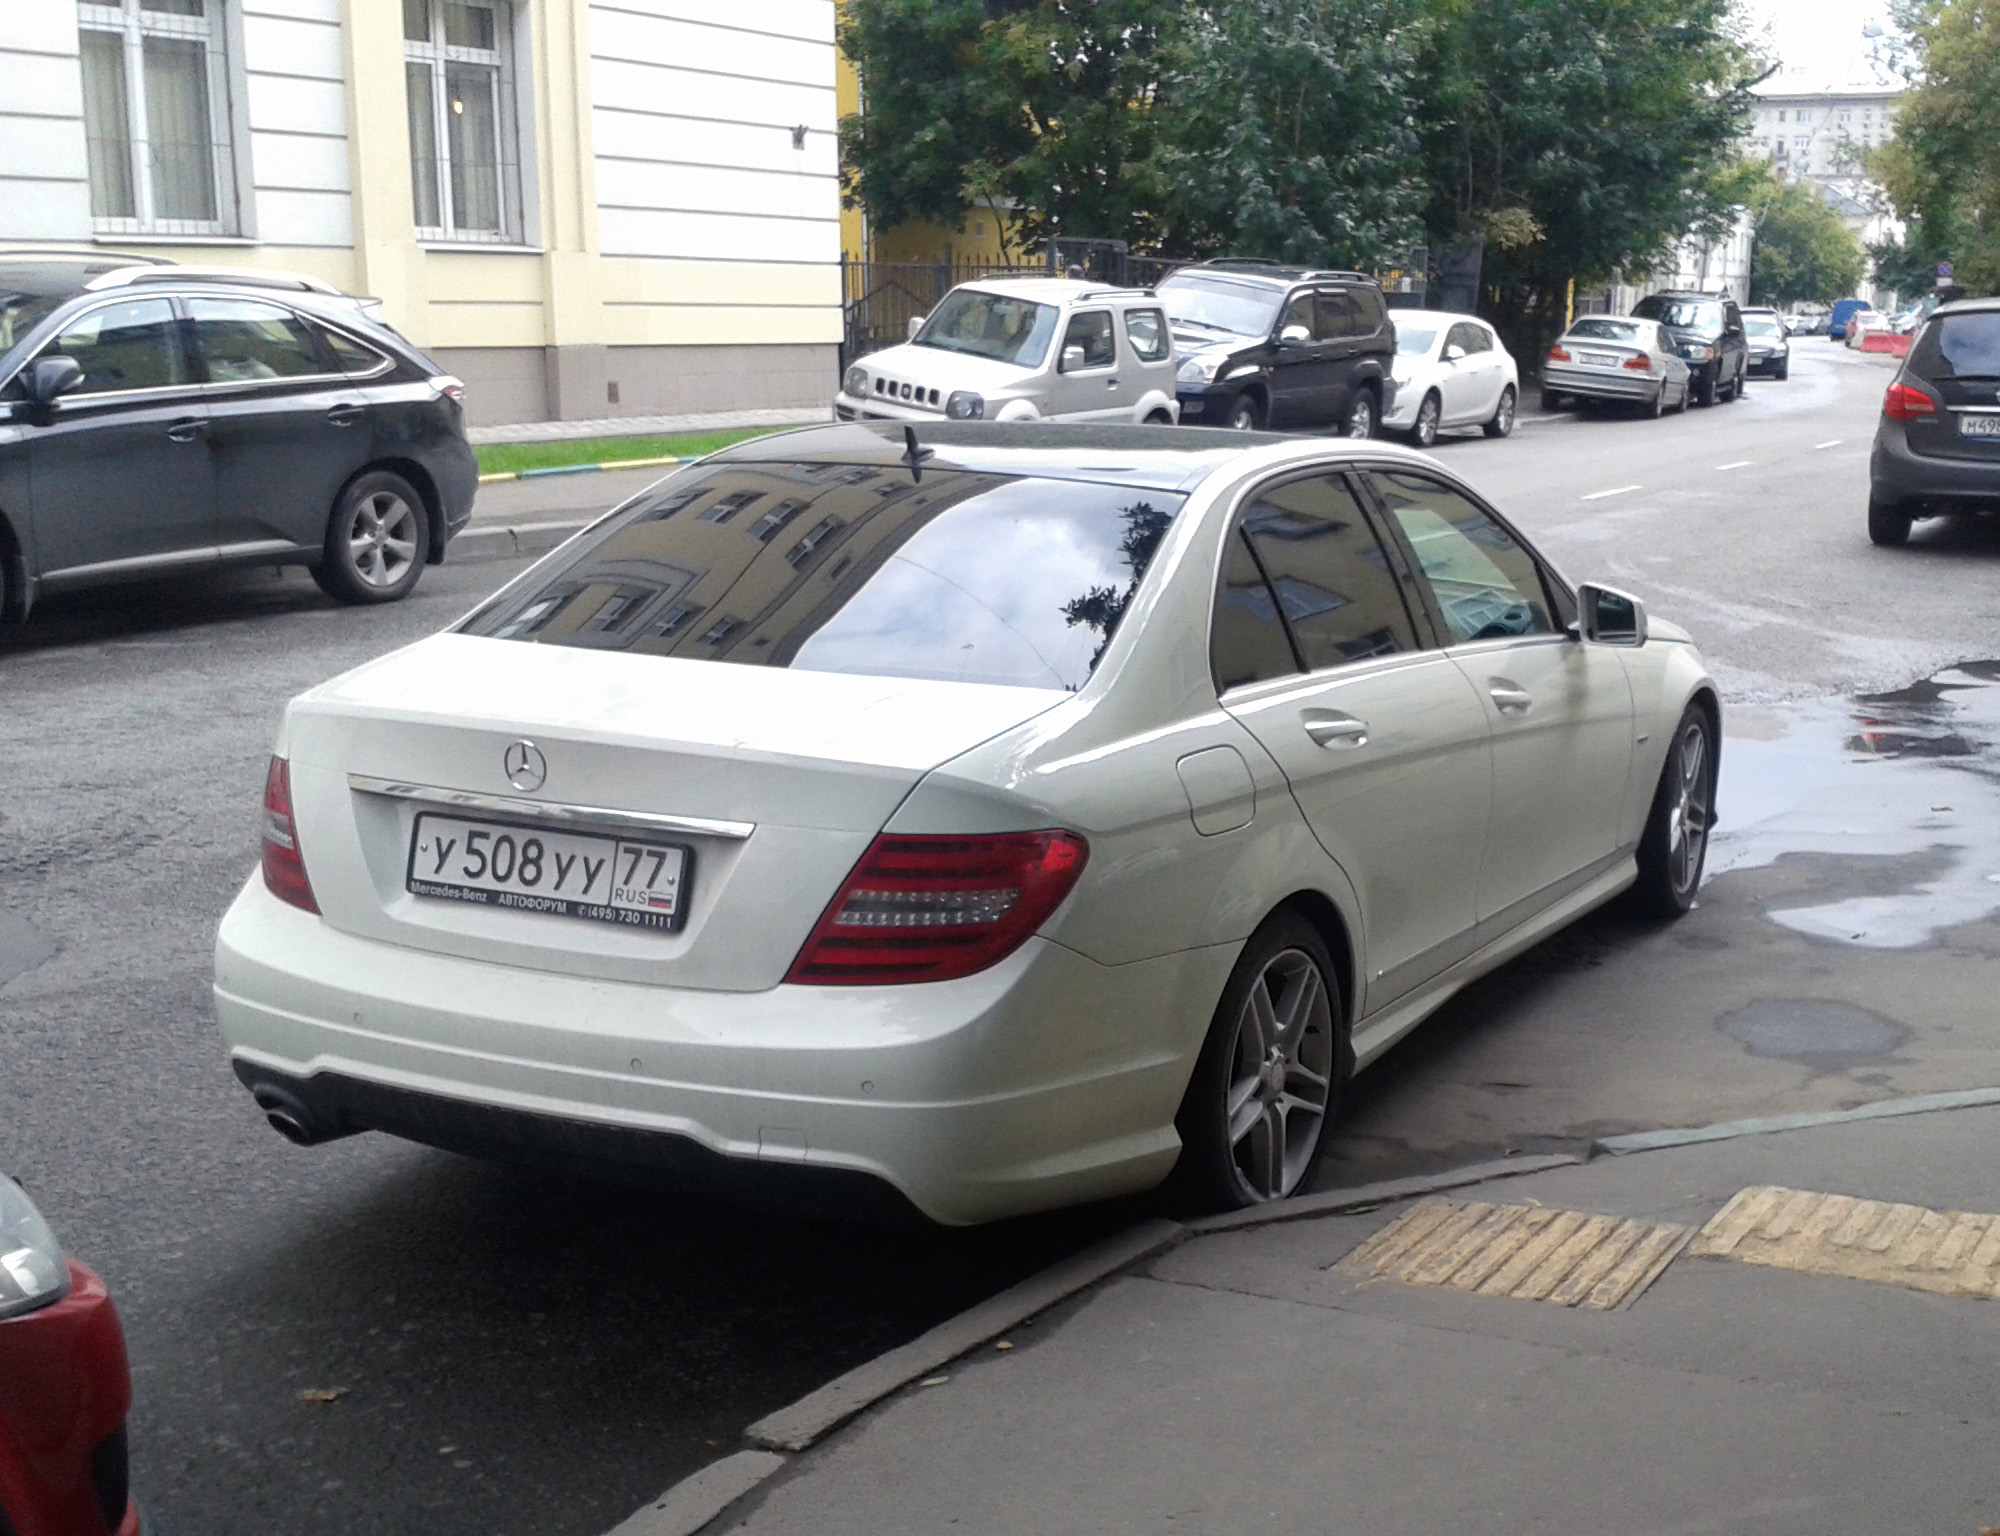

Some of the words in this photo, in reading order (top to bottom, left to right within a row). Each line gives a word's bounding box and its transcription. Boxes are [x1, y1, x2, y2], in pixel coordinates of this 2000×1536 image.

[622, 846, 668, 889] 77
[410, 881, 487, 902] Mercedes-Benz
[498, 893, 567, 914] АВТОФОРУМ
[619, 909, 640, 924] 730
[644, 913, 672, 928] 1111
[614, 888, 647, 905] RUS
